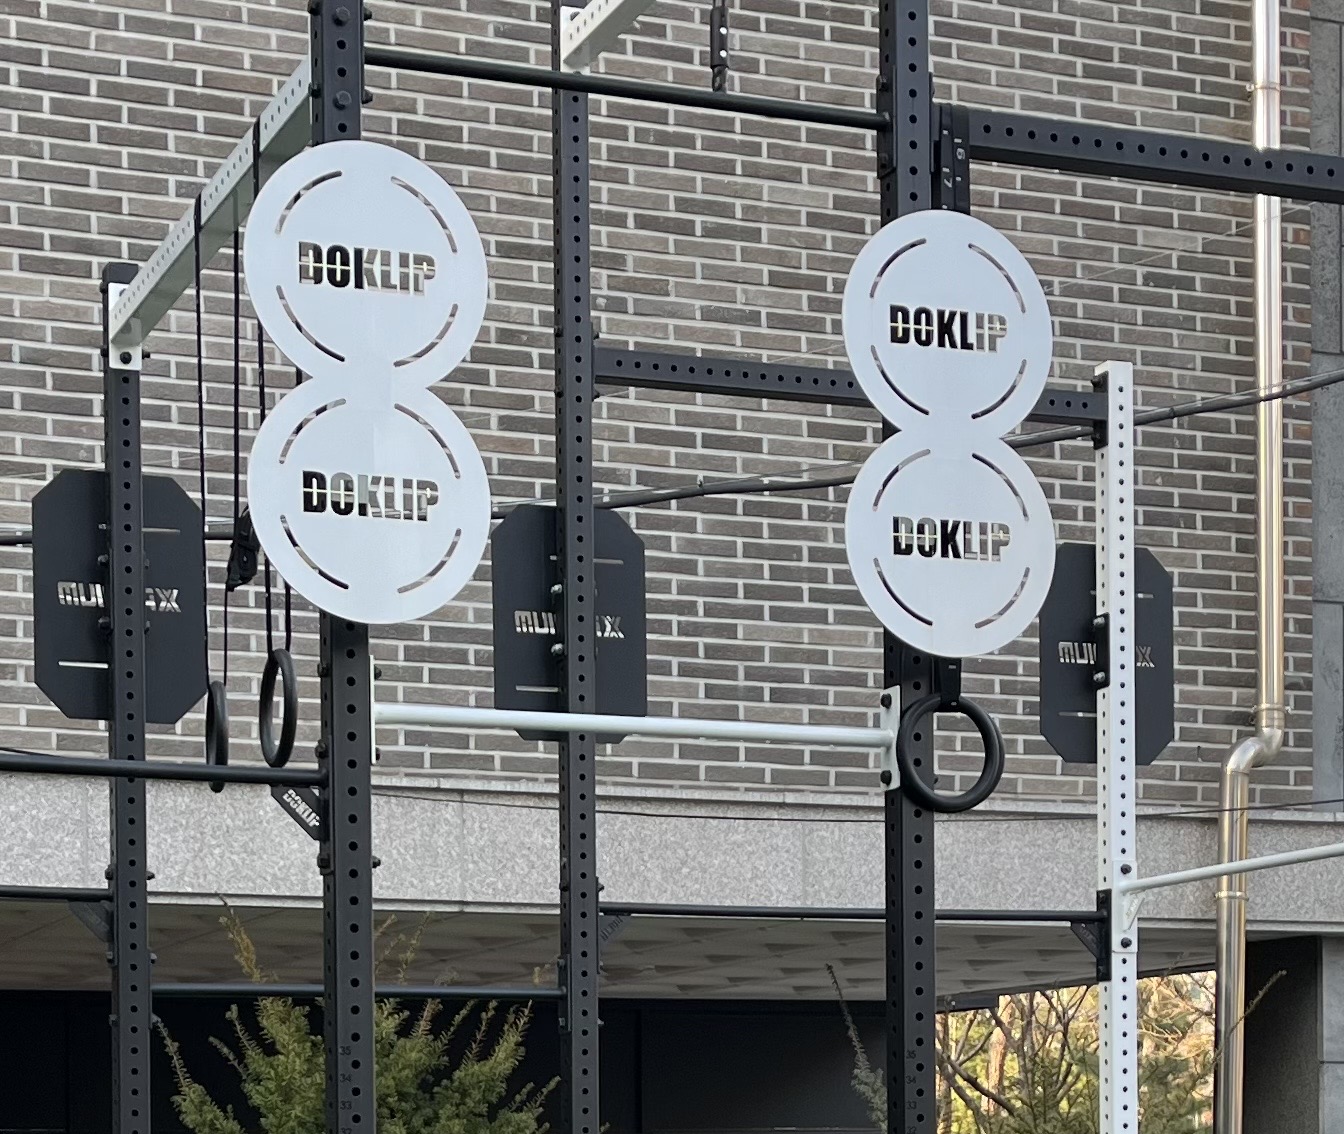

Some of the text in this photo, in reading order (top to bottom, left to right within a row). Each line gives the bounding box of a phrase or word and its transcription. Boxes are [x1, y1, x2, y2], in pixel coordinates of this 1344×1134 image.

[298, 242, 436, 296] DOKLIP
[889, 304, 1009, 353] DOKLIP
[302, 471, 440, 522] DOKLIP
[892, 516, 1012, 562] DOKLIP
